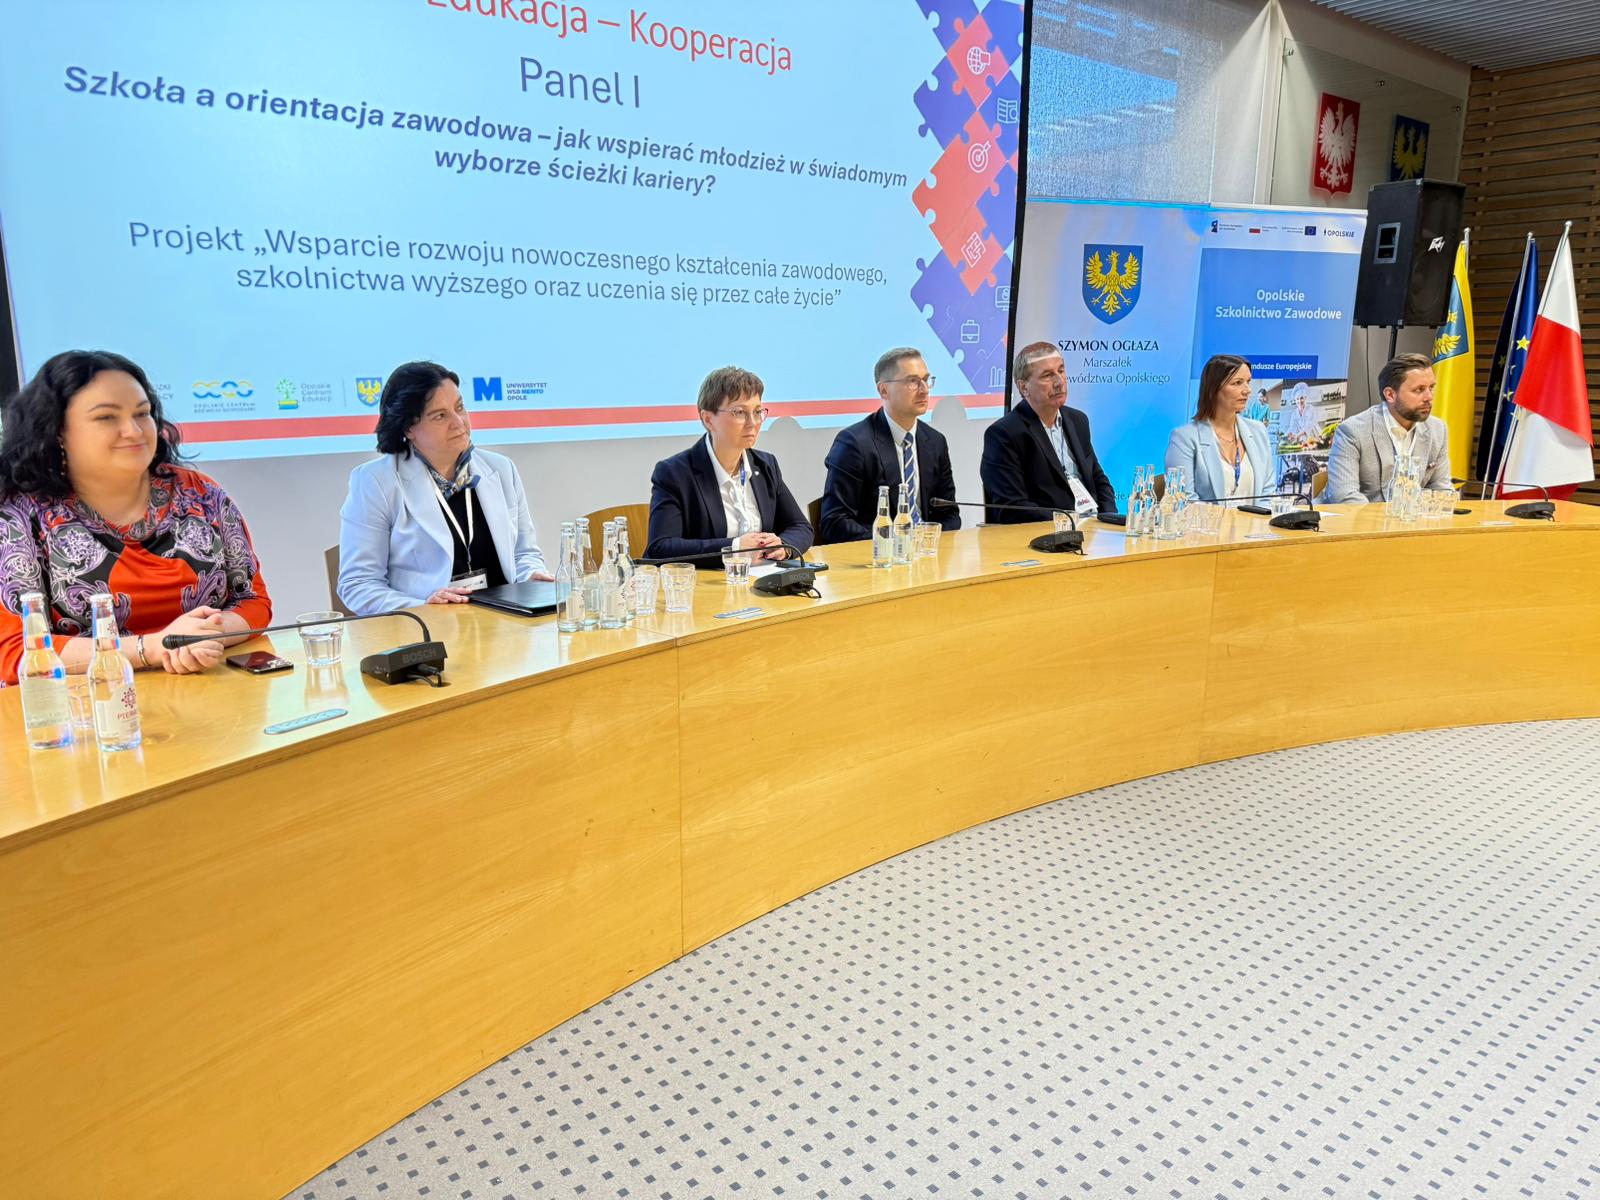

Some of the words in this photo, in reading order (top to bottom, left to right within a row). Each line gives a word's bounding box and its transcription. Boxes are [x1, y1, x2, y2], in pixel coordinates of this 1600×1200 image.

[426, 0, 588, 38] ukacja
[630, 9, 792, 76] Kooperacja
[520, 57, 623, 106] Panel
[64, 66, 185, 104] Szkoła
[195, 88, 215, 108] a
[225, 89, 384, 129] orientacja
[391, 110, 532, 143] zawodowa
[553, 126, 591, 151] jak
[597, 135, 694, 163] wspierać
[700, 148, 785, 173] młodzież
[789, 160, 805, 176] w
[808, 158, 908, 188] świadomym
[434, 148, 542, 176] wyborze
[547, 157, 627, 186] ścieżki
[632, 168, 716, 195] kariery?
[1328, 229, 1356, 238] OPOLSKIE
[129, 222, 244, 256] Projekt
[253, 229, 401, 261] „Wsparcie
[408, 238, 505, 265] rozwoju
[511, 246, 671, 275] nowoczesnego
[675, 253, 777, 277] kształcenia
[781, 264, 888, 286] zawodowego,
[236, 264, 405, 293] szkolnictwa
[412, 272, 527, 299] wyższego
[534, 278, 581, 297] oraz
[586, 278, 665, 301] uczenia
[670, 283, 697, 307] się
[702, 286, 750, 307] przez
[754, 285, 790, 306] całe
[793, 289, 842, 309] życie”
[1256, 288, 1305, 303] Opolskie
[1216, 306, 1282, 319] Szkolnictwo
[1285, 308, 1342, 320] Zawodowe
[1058, 340, 1109, 352] SZYMON
[1112, 340, 1160, 351] OGŁAZA
[1083, 356, 1132, 368] Marszałek
[1276, 363, 1312, 371] Europejskie
[1066, 373, 1113, 384] wództwa
[1116, 372, 1171, 385] Opolskiego
[402, 648, 437, 664] BOSCH
